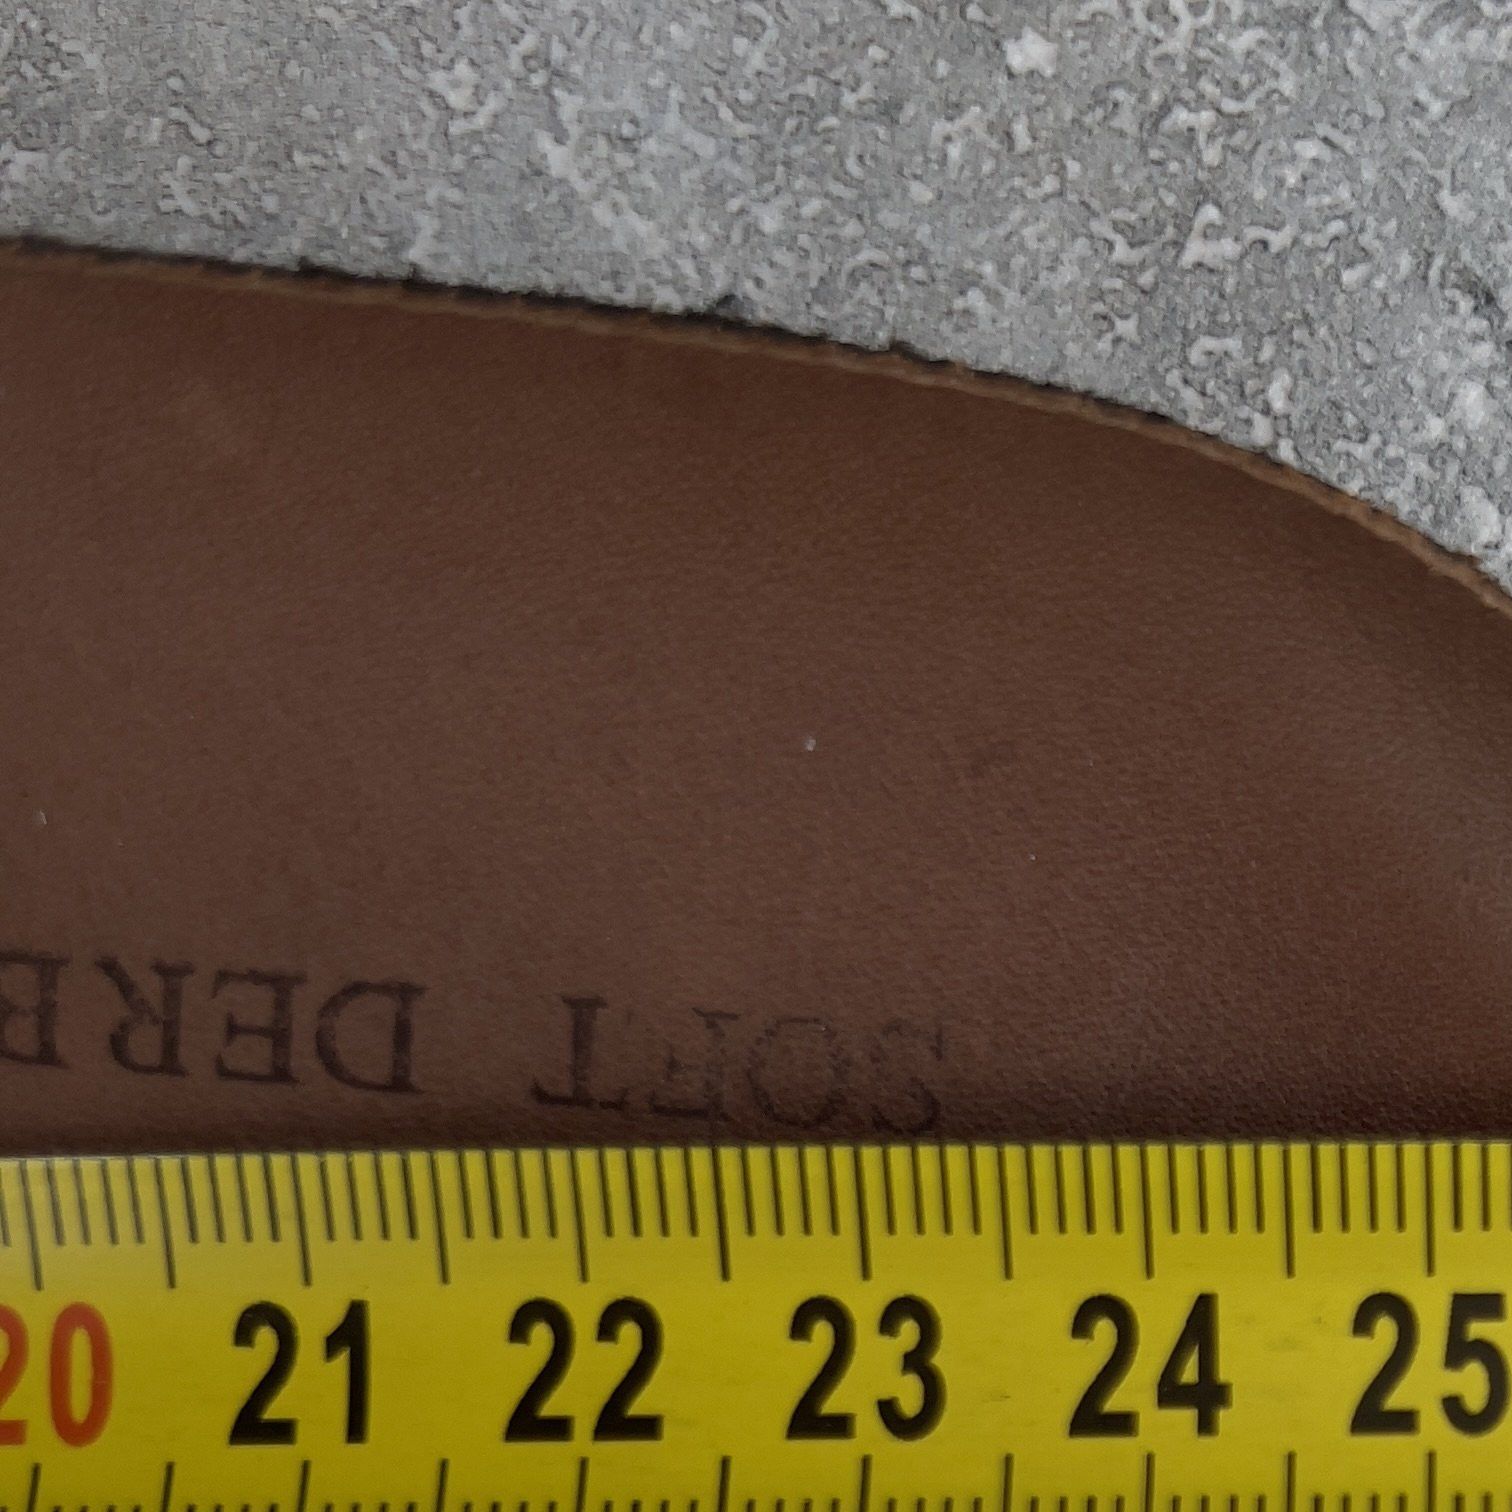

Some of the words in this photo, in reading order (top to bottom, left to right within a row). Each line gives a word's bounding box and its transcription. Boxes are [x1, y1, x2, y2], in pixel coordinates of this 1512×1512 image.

[0, 948, 426, 1096] DERB
[530, 995, 945, 1134] SOFT
[227, 1299, 370, 1446] 21
[503, 1296, 664, 1443] 22
[785, 1294, 945, 1441] 23
[1068, 1293, 1231, 1438] 24
[1350, 1292, 1509, 1436] 25
